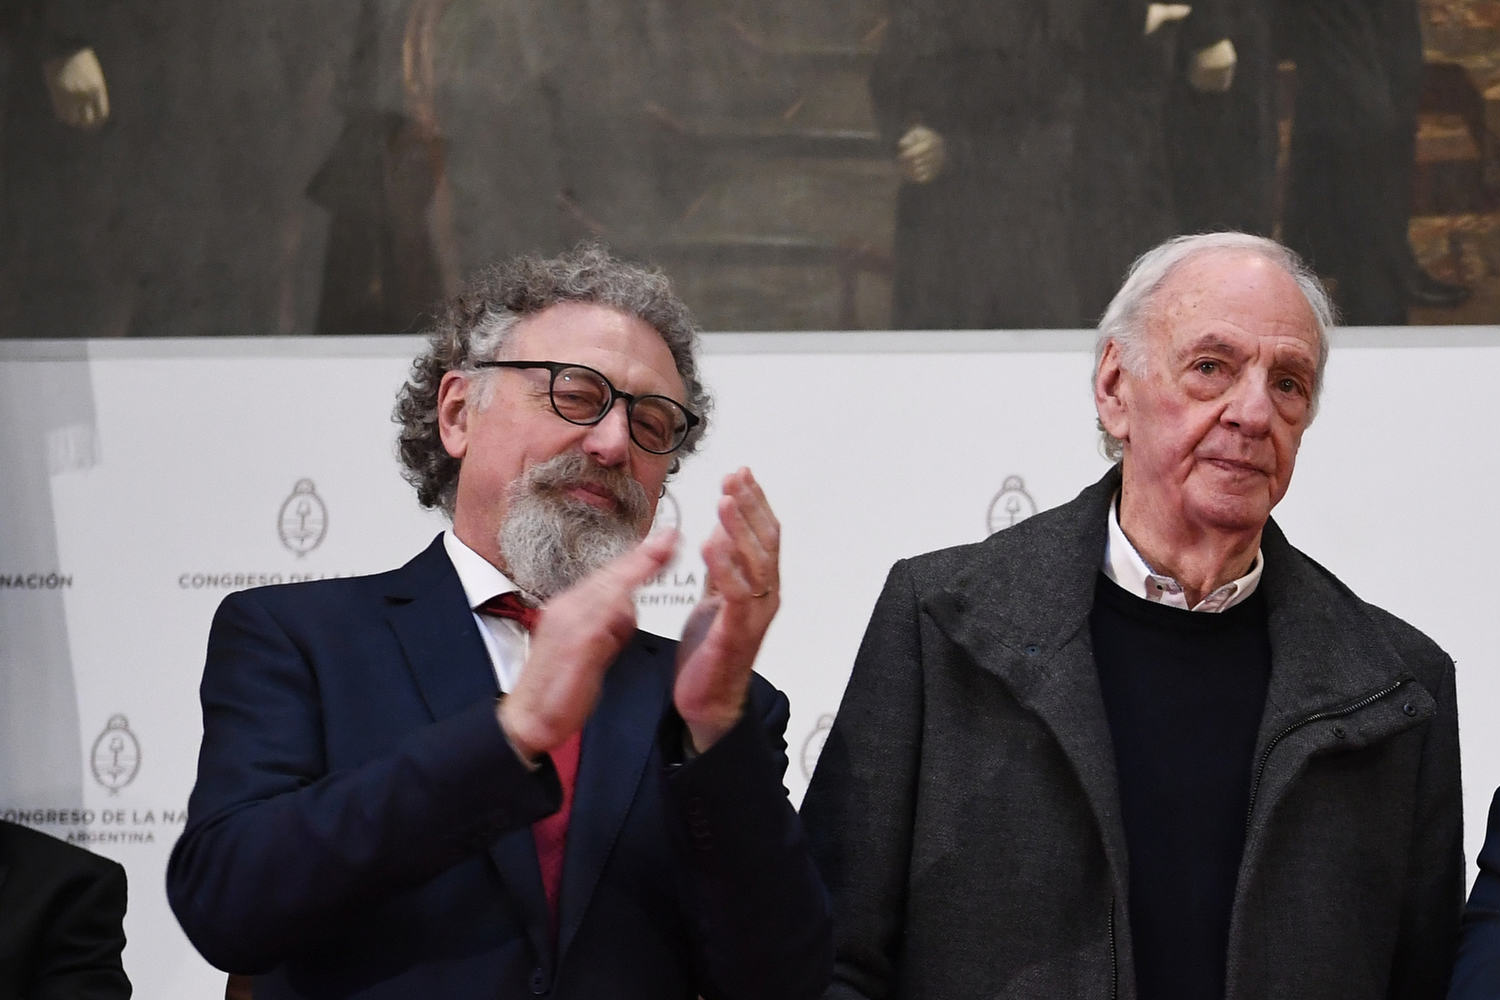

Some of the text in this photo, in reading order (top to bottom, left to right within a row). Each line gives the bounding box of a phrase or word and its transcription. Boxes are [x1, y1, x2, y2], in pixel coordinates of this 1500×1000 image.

[0, 570, 73, 589] NACIÓN
[178, 573, 283, 589] CONGRESO
[673, 573, 697, 586] LA
[3, 809, 95, 825] ONGRESO
[102, 810, 126, 824] DE
[132, 810, 155, 824] LA
[67, 831, 154, 843] ARGENTINA
